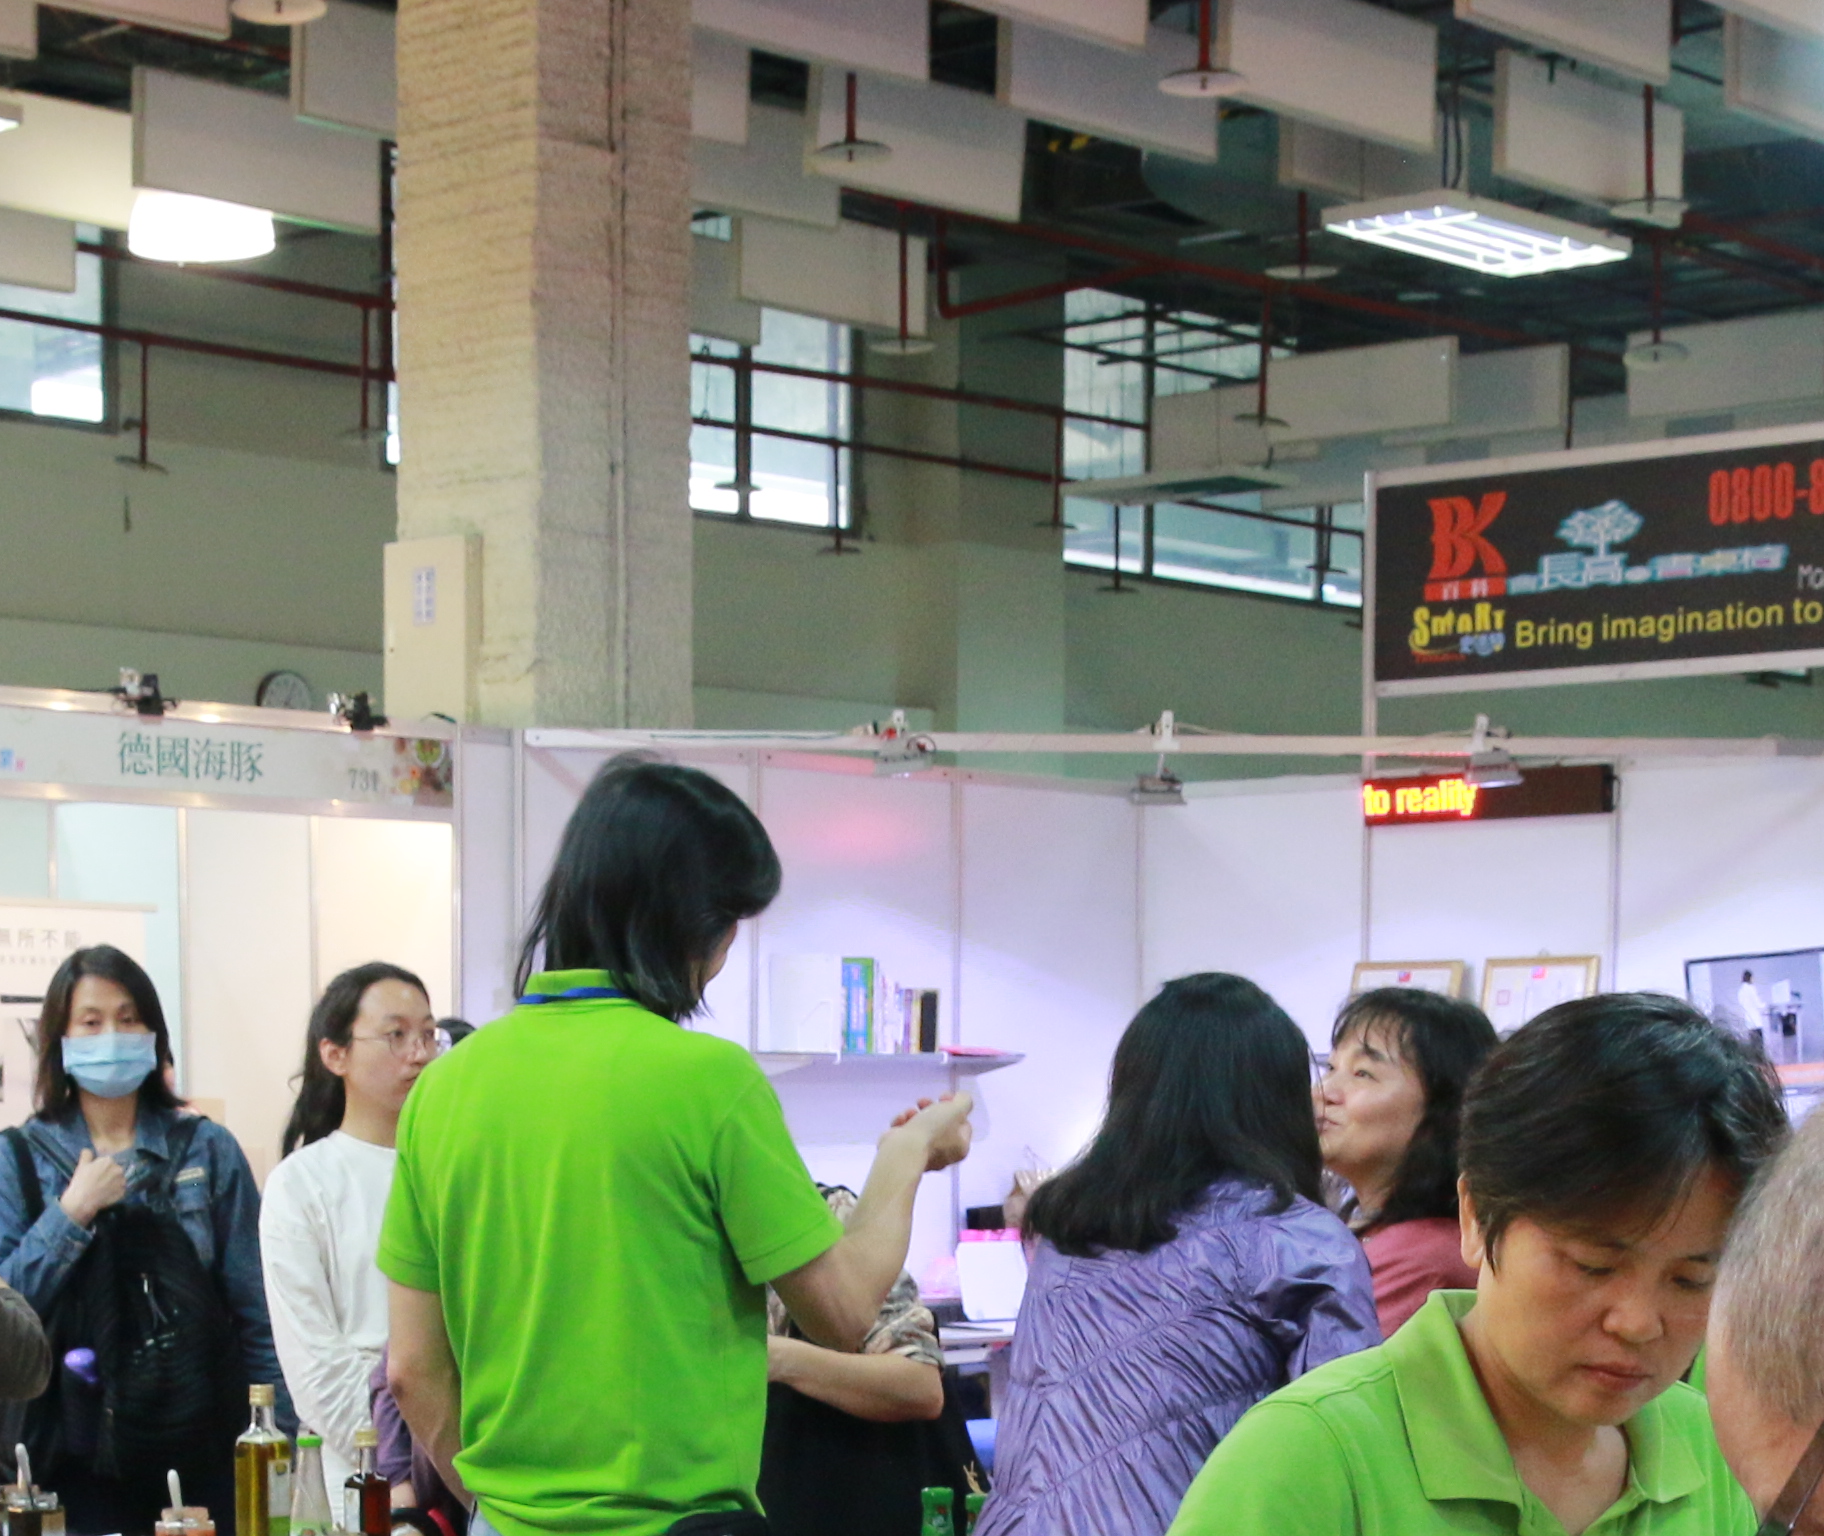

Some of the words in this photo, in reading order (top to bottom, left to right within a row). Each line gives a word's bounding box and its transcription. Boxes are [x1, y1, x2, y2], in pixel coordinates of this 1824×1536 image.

[1514, 615, 1594, 650] Bring
[1601, 600, 1784, 643] imagination
[1793, 595, 1824, 624] to
[118, 731, 263, 783] 德國海豚
[1363, 783, 1391, 816] to
[1395, 778, 1478, 817] reality
